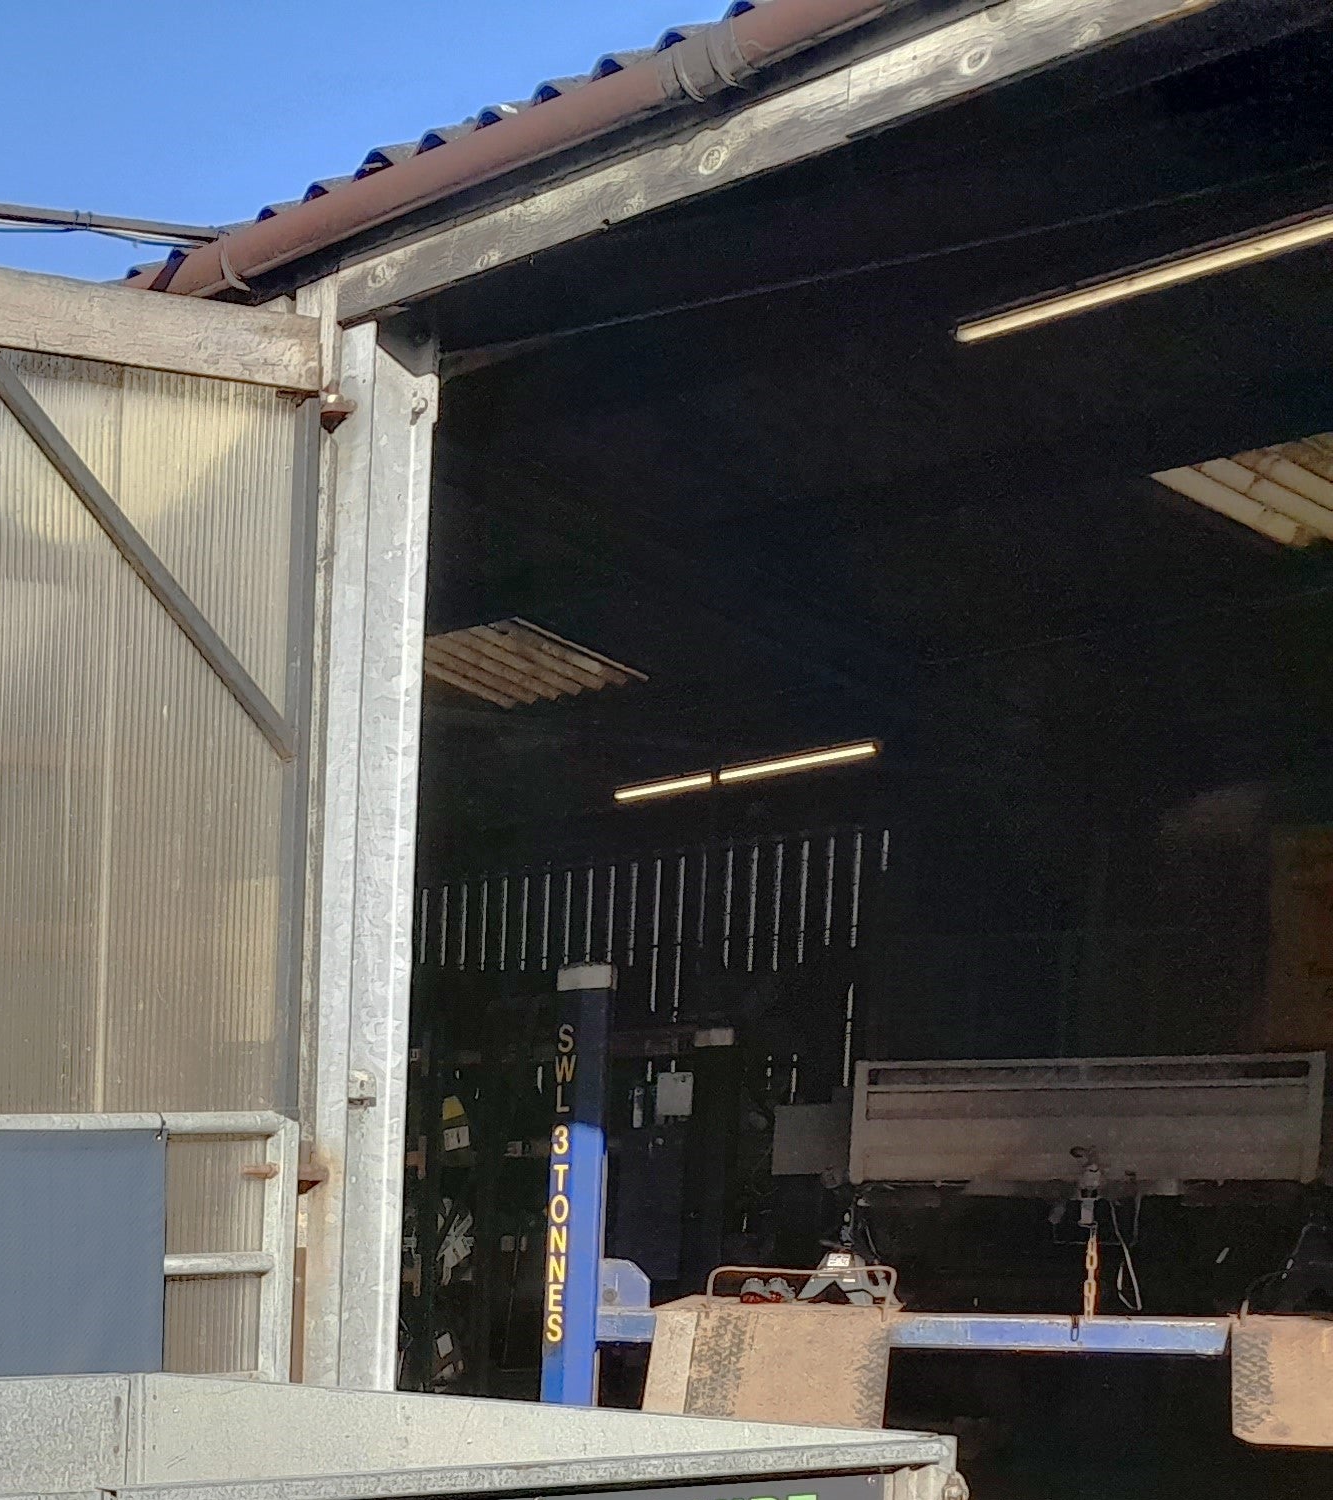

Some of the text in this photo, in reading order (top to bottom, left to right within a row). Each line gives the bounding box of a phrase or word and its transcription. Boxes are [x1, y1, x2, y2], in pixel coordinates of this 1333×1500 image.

[546, 1023, 576, 1342] SWL 3 TONNES
